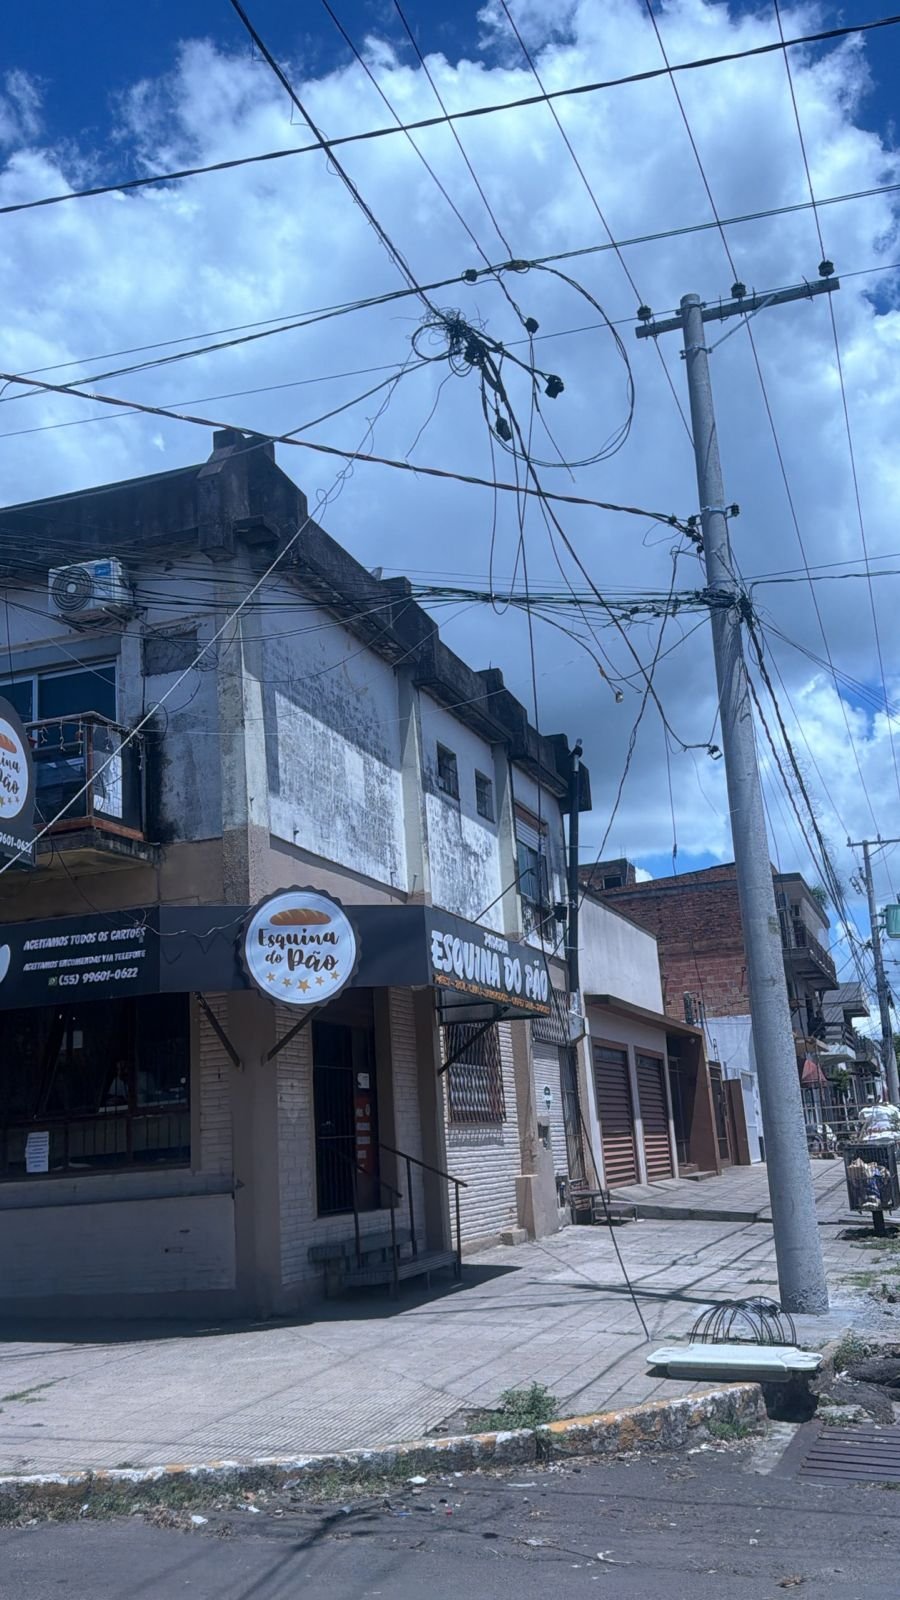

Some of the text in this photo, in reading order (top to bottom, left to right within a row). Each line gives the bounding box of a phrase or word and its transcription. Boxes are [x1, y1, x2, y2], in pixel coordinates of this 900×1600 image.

[23, 935, 69, 951] ACEITAMOS
[70, 932, 97, 945] TODOS
[98, 931, 109, 942] OS
[258, 928, 340, 950] Esquina
[23, 960, 58, 972] ACEITAMOS
[102, 954, 114, 963] VIA
[114, 949, 147, 962] TELEFONE
[265, 948, 340, 972] do Pão
[431, 929, 501, 989] ESQUINA
[503, 956, 523, 995] DO
[524, 959, 549, 1003] PÃO
[58, 967, 139, 986] (55) 99601-0622
